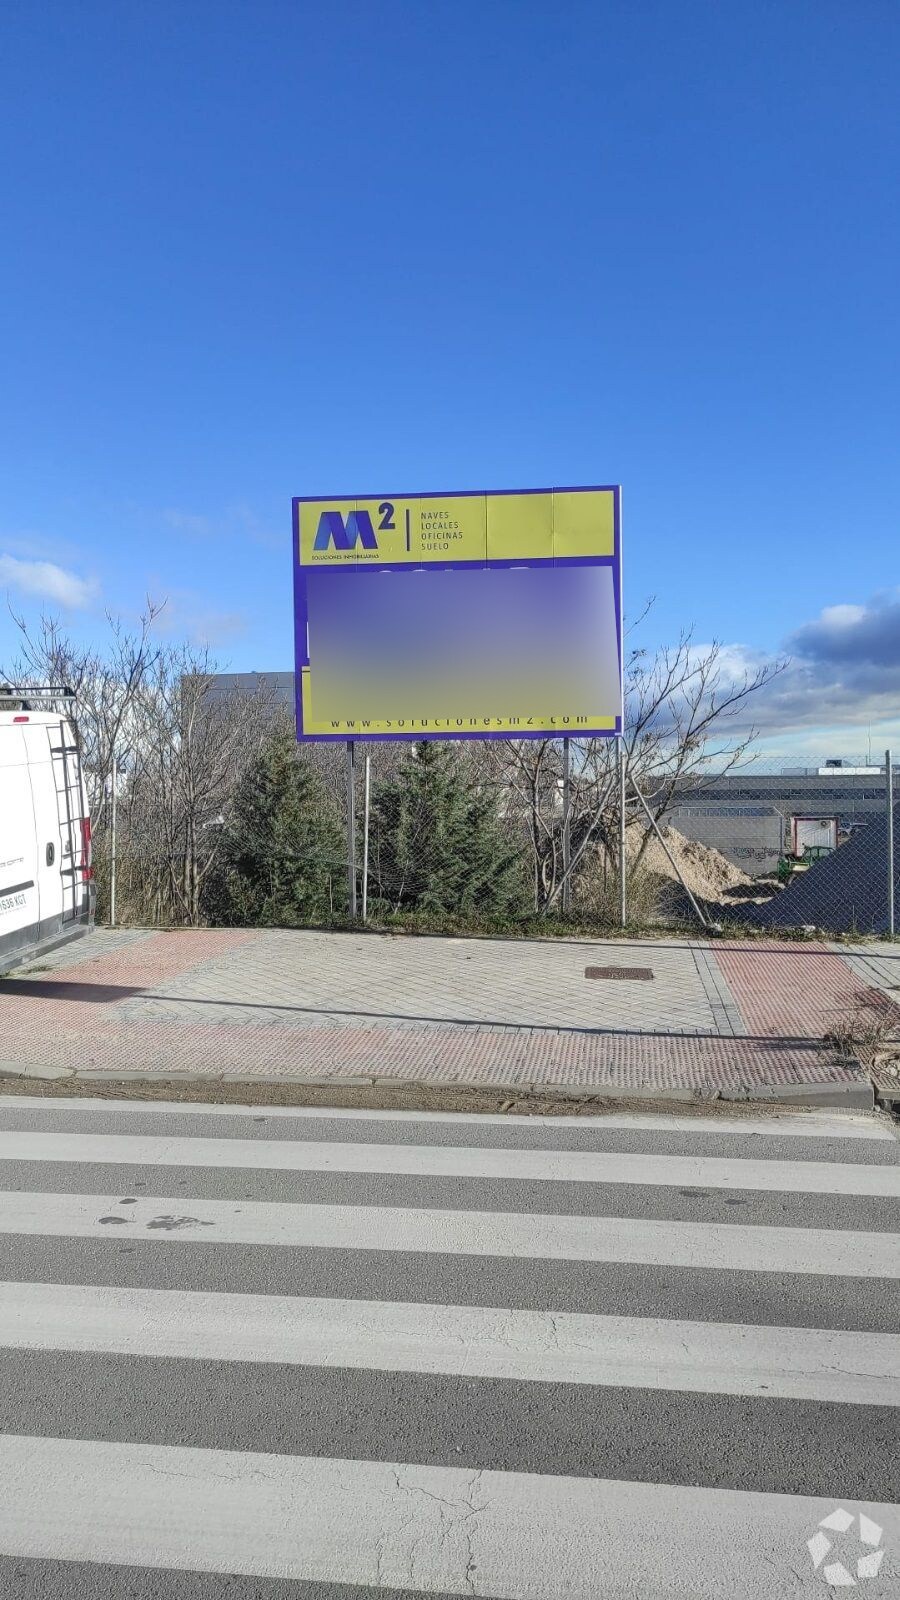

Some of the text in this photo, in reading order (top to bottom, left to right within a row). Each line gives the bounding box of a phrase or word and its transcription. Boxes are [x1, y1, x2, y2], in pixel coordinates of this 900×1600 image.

[421, 511, 449, 520] NAVES
[421, 521, 459, 530] LOCALES
[421, 531, 463, 541] OFICINAS
[421, 542, 449, 551] SUELO
